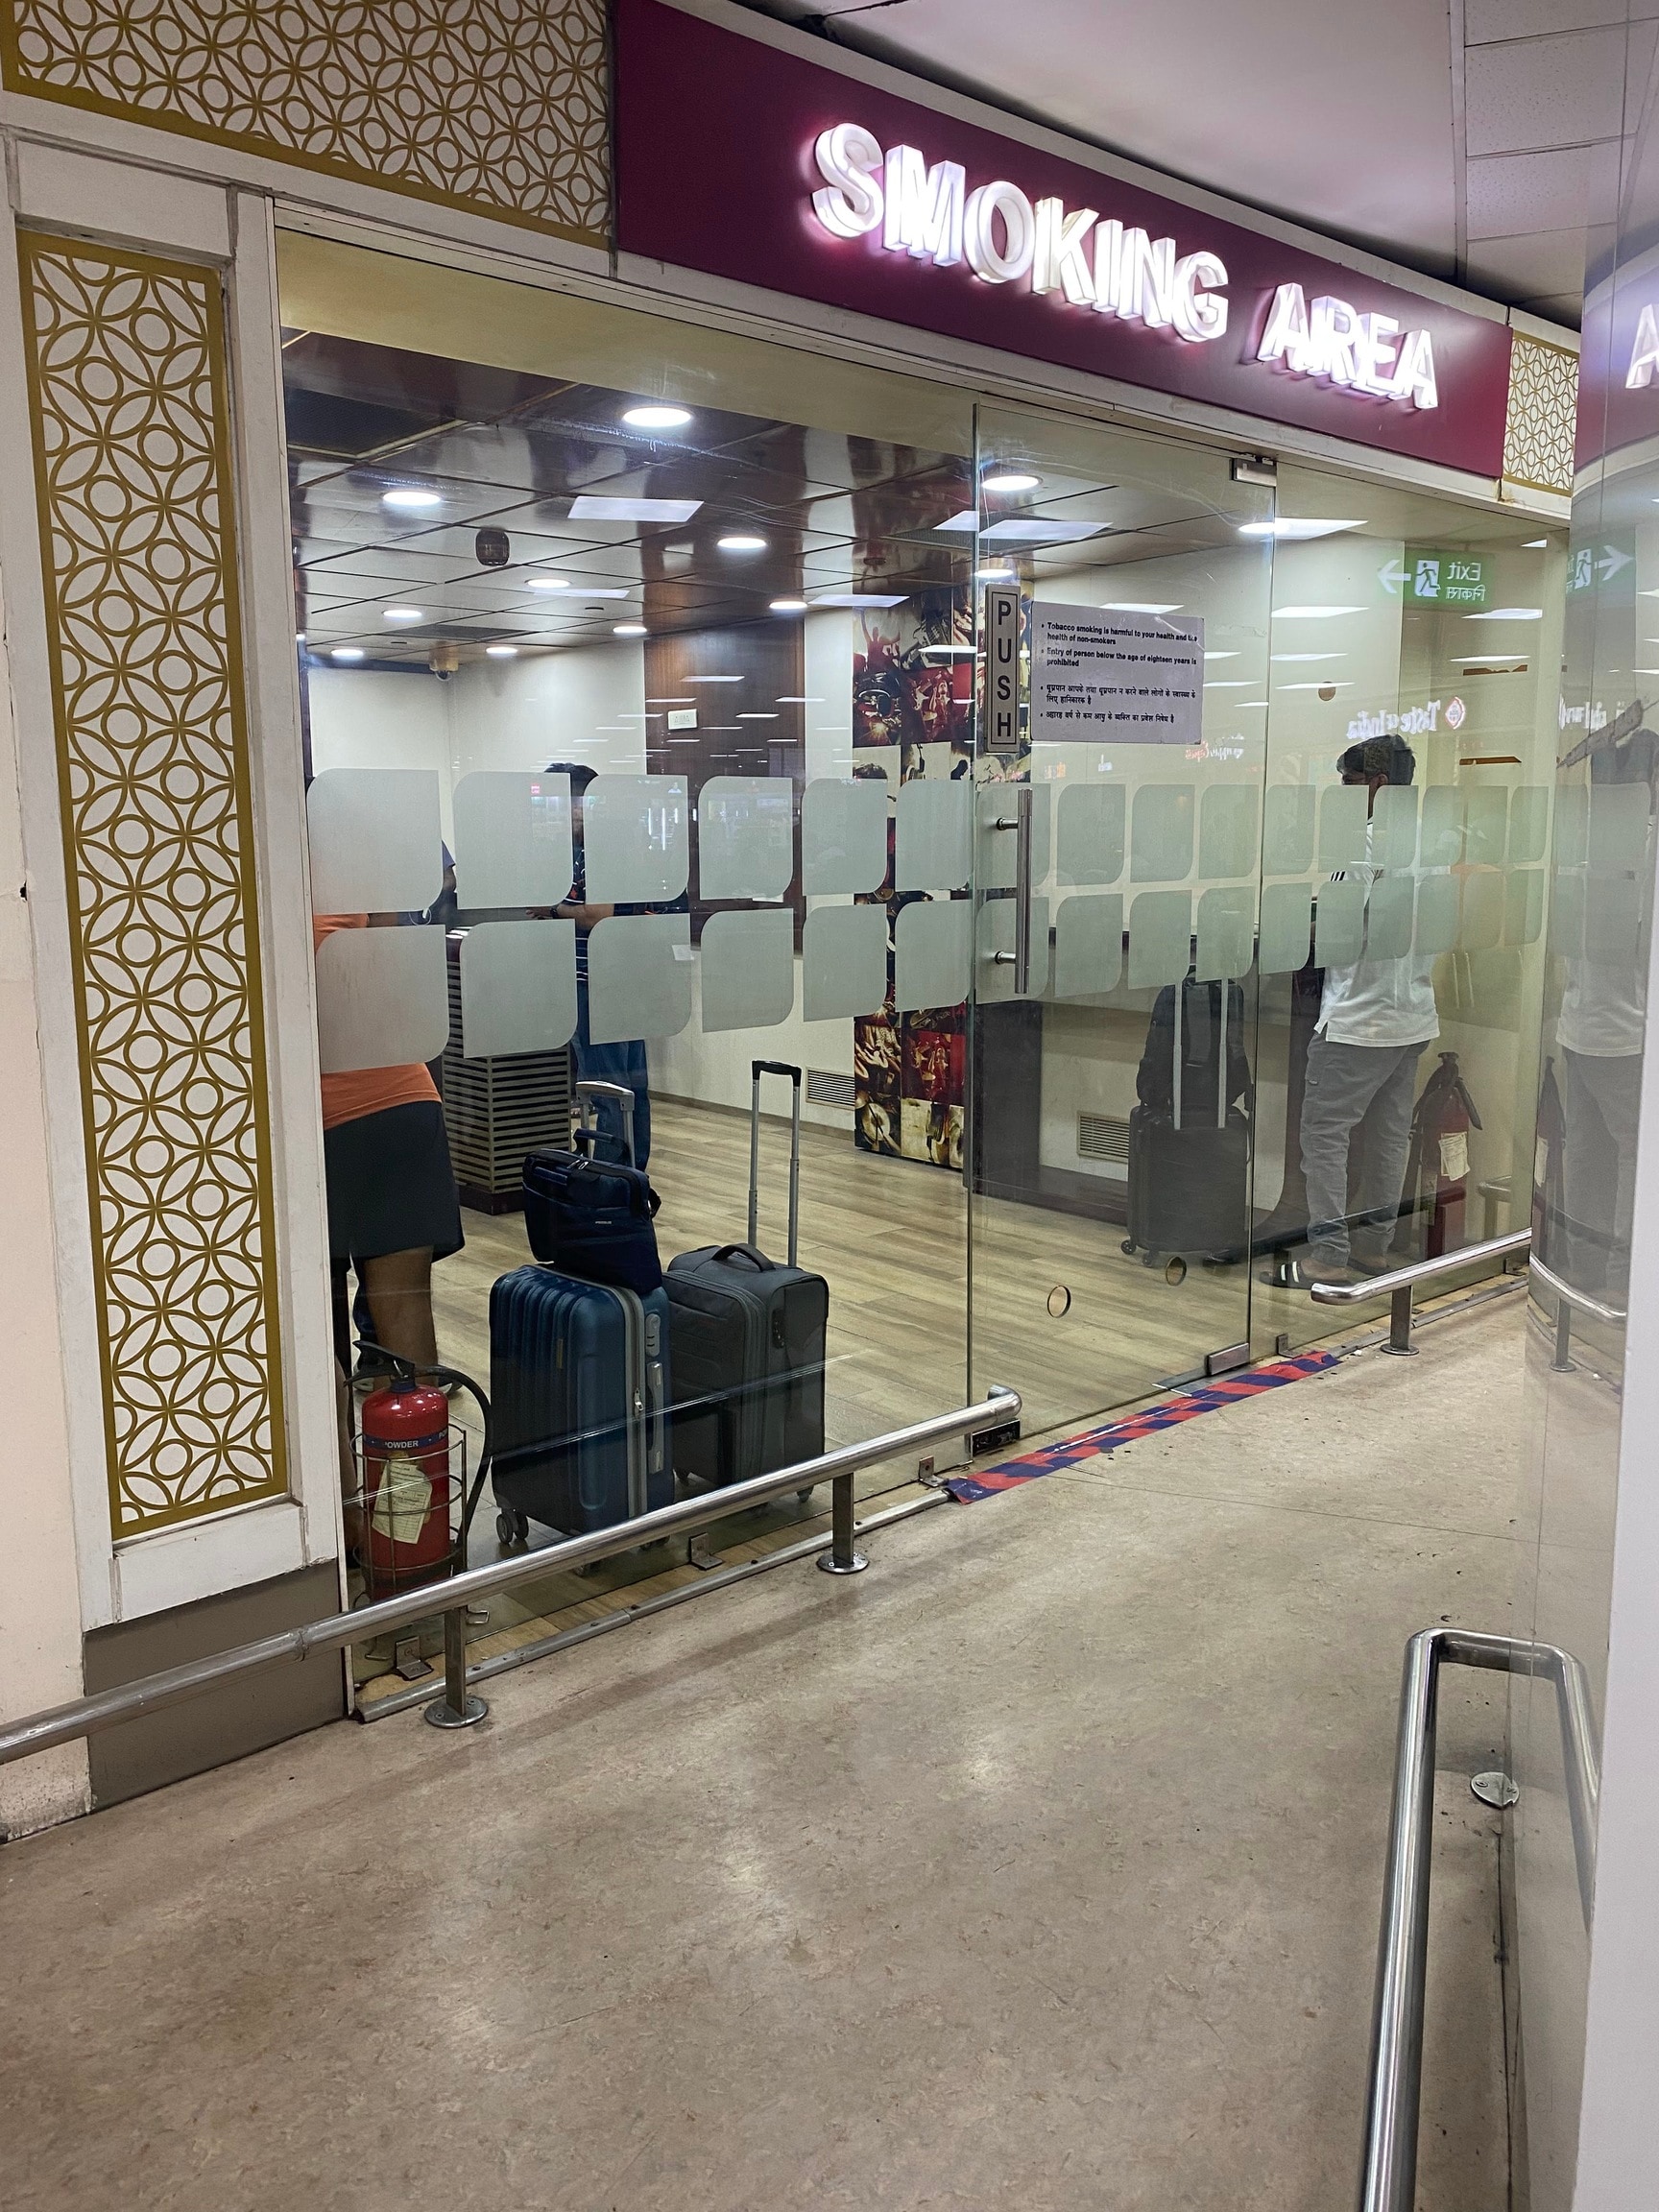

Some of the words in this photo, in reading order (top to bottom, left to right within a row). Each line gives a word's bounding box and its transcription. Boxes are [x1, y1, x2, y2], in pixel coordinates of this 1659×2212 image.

[811, 122, 1229, 343] SMOKING
[1258, 282, 1438, 410] AREA
[1047, 622, 1075, 632] Tobacco
[1077, 626, 1102, 635] smoking
[1046, 633, 1068, 641] health
[1077, 636, 1116, 645] non-smokers
[1046, 647, 1064, 657] Entry
[1147, 655, 1172, 663] eighteen
[997, 600, 1011, 736] PUSH
[1166, 687, 1169, 697] के
